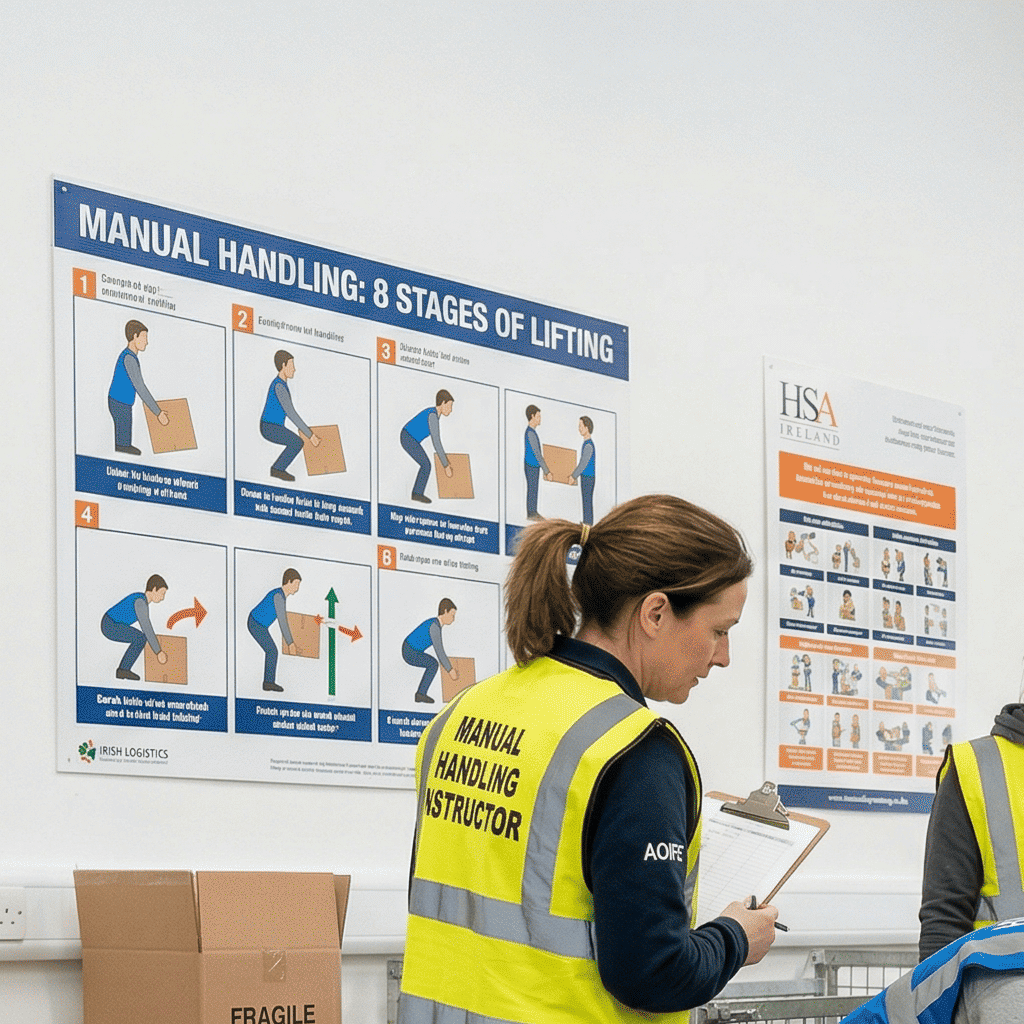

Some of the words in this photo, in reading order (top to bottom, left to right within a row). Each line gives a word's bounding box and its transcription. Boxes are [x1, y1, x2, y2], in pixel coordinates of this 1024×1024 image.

[78, 275, 88, 294] 1
[79, 203, 209, 267] MANUAL
[218, 237, 366, 304] HANDLING:
[373, 277, 389, 309] 8
[396, 282, 489, 333] STAGES
[495, 307, 525, 341] OF
[531, 315, 614, 364] LIFTING
[237, 310, 248, 328] 2
[381, 342, 391, 360] 3
[780, 380, 839, 428] HSA
[780, 423, 840, 446] IRELAND
[80, 506, 93, 524] 4
[454, 716, 526, 756] MANUAL
[100, 745, 122, 757] IRISH
[434, 751, 520, 798] HANDLING
[426, 788, 522, 841] NSTRUCTOR
[643, 842, 685, 862] AOIFE
